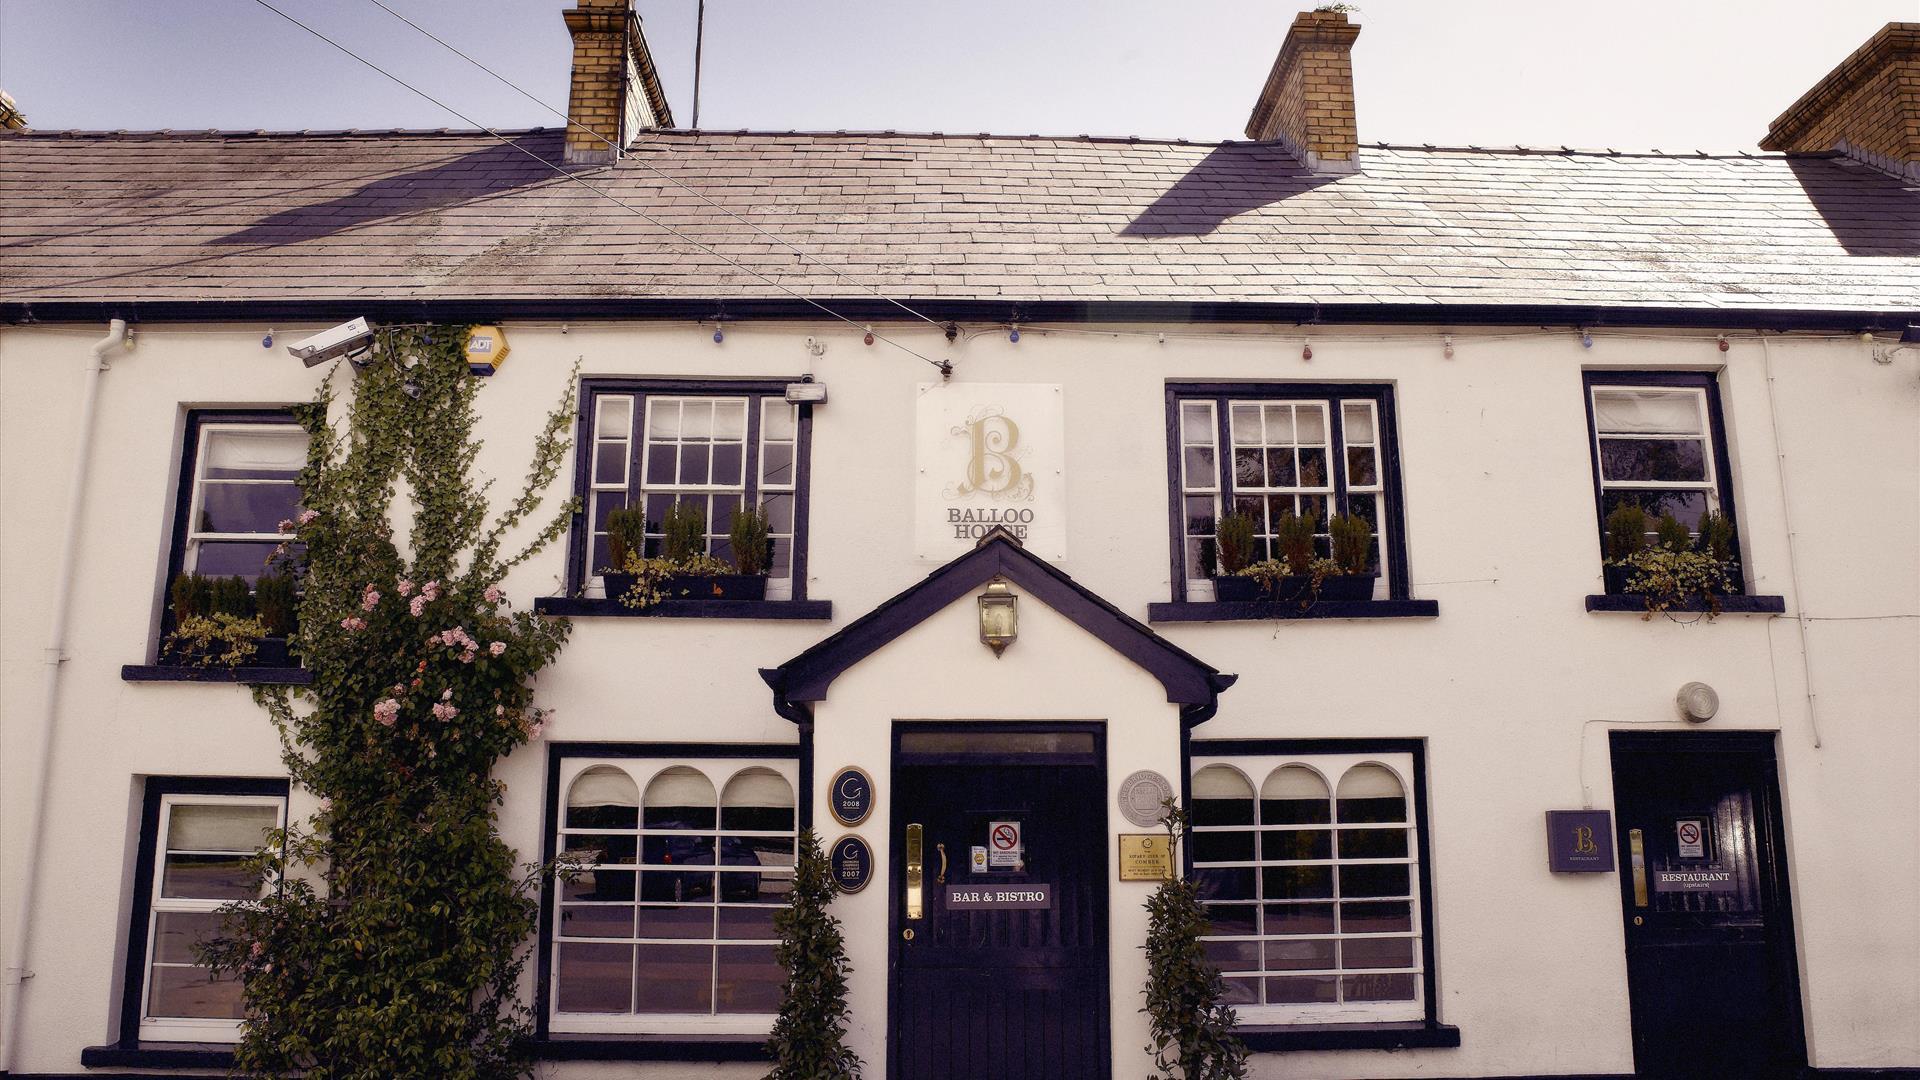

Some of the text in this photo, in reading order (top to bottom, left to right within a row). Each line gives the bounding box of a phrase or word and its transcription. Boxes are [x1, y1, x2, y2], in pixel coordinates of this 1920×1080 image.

[470, 339, 492, 350] ADT
[952, 412, 1026, 498] B
[947, 508, 1034, 524] BALLOO
[954, 524, 1028, 539] HOE
[1574, 826, 1598, 854] B
[1662, 872, 1730, 882] RESTAURANT
[952, 892, 1045, 902] BAR & BISTRO
